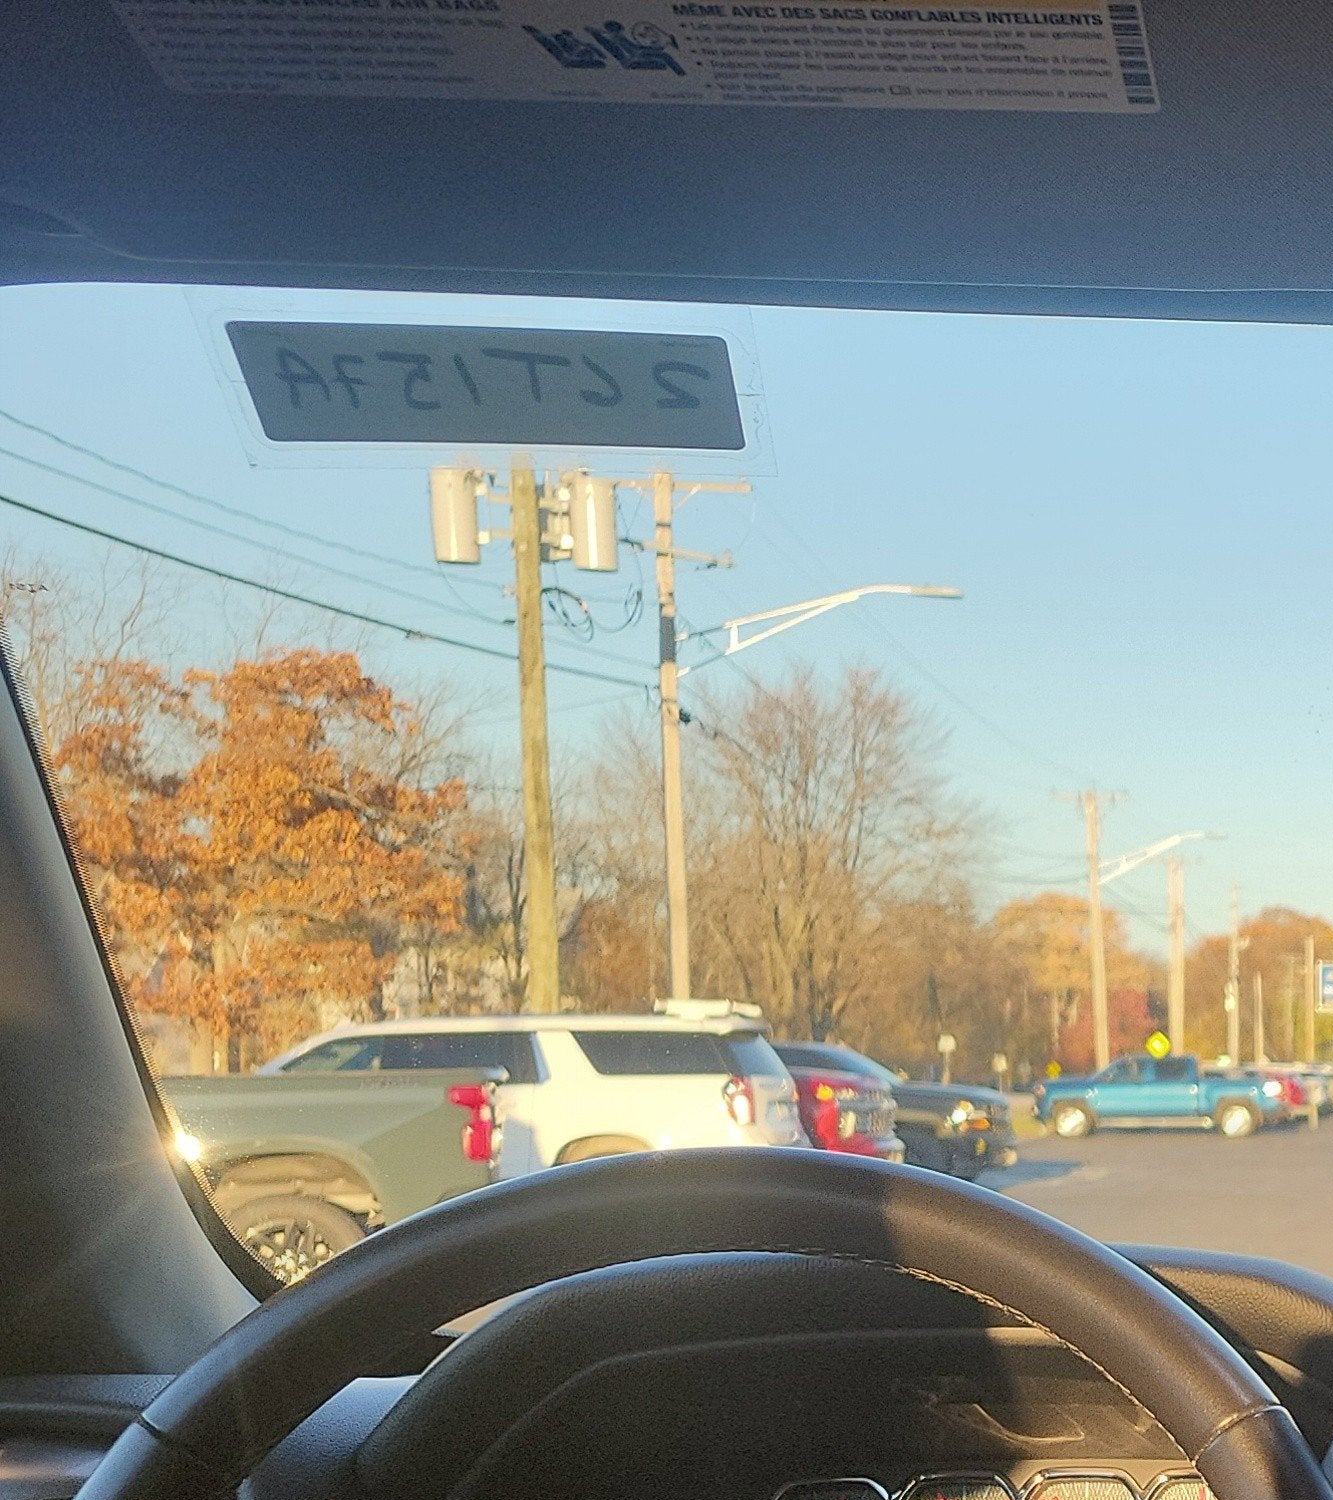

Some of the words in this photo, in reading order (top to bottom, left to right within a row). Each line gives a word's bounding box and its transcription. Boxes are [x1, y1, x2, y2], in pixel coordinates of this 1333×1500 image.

[732, 6, 777, 18] AVEC
[781, 7, 816, 19] DES
[819, 8, 867, 21] SACS
[871, 9, 981, 23] GONFLABLES
[986, 11, 1103, 25] INTELLIGENTS
